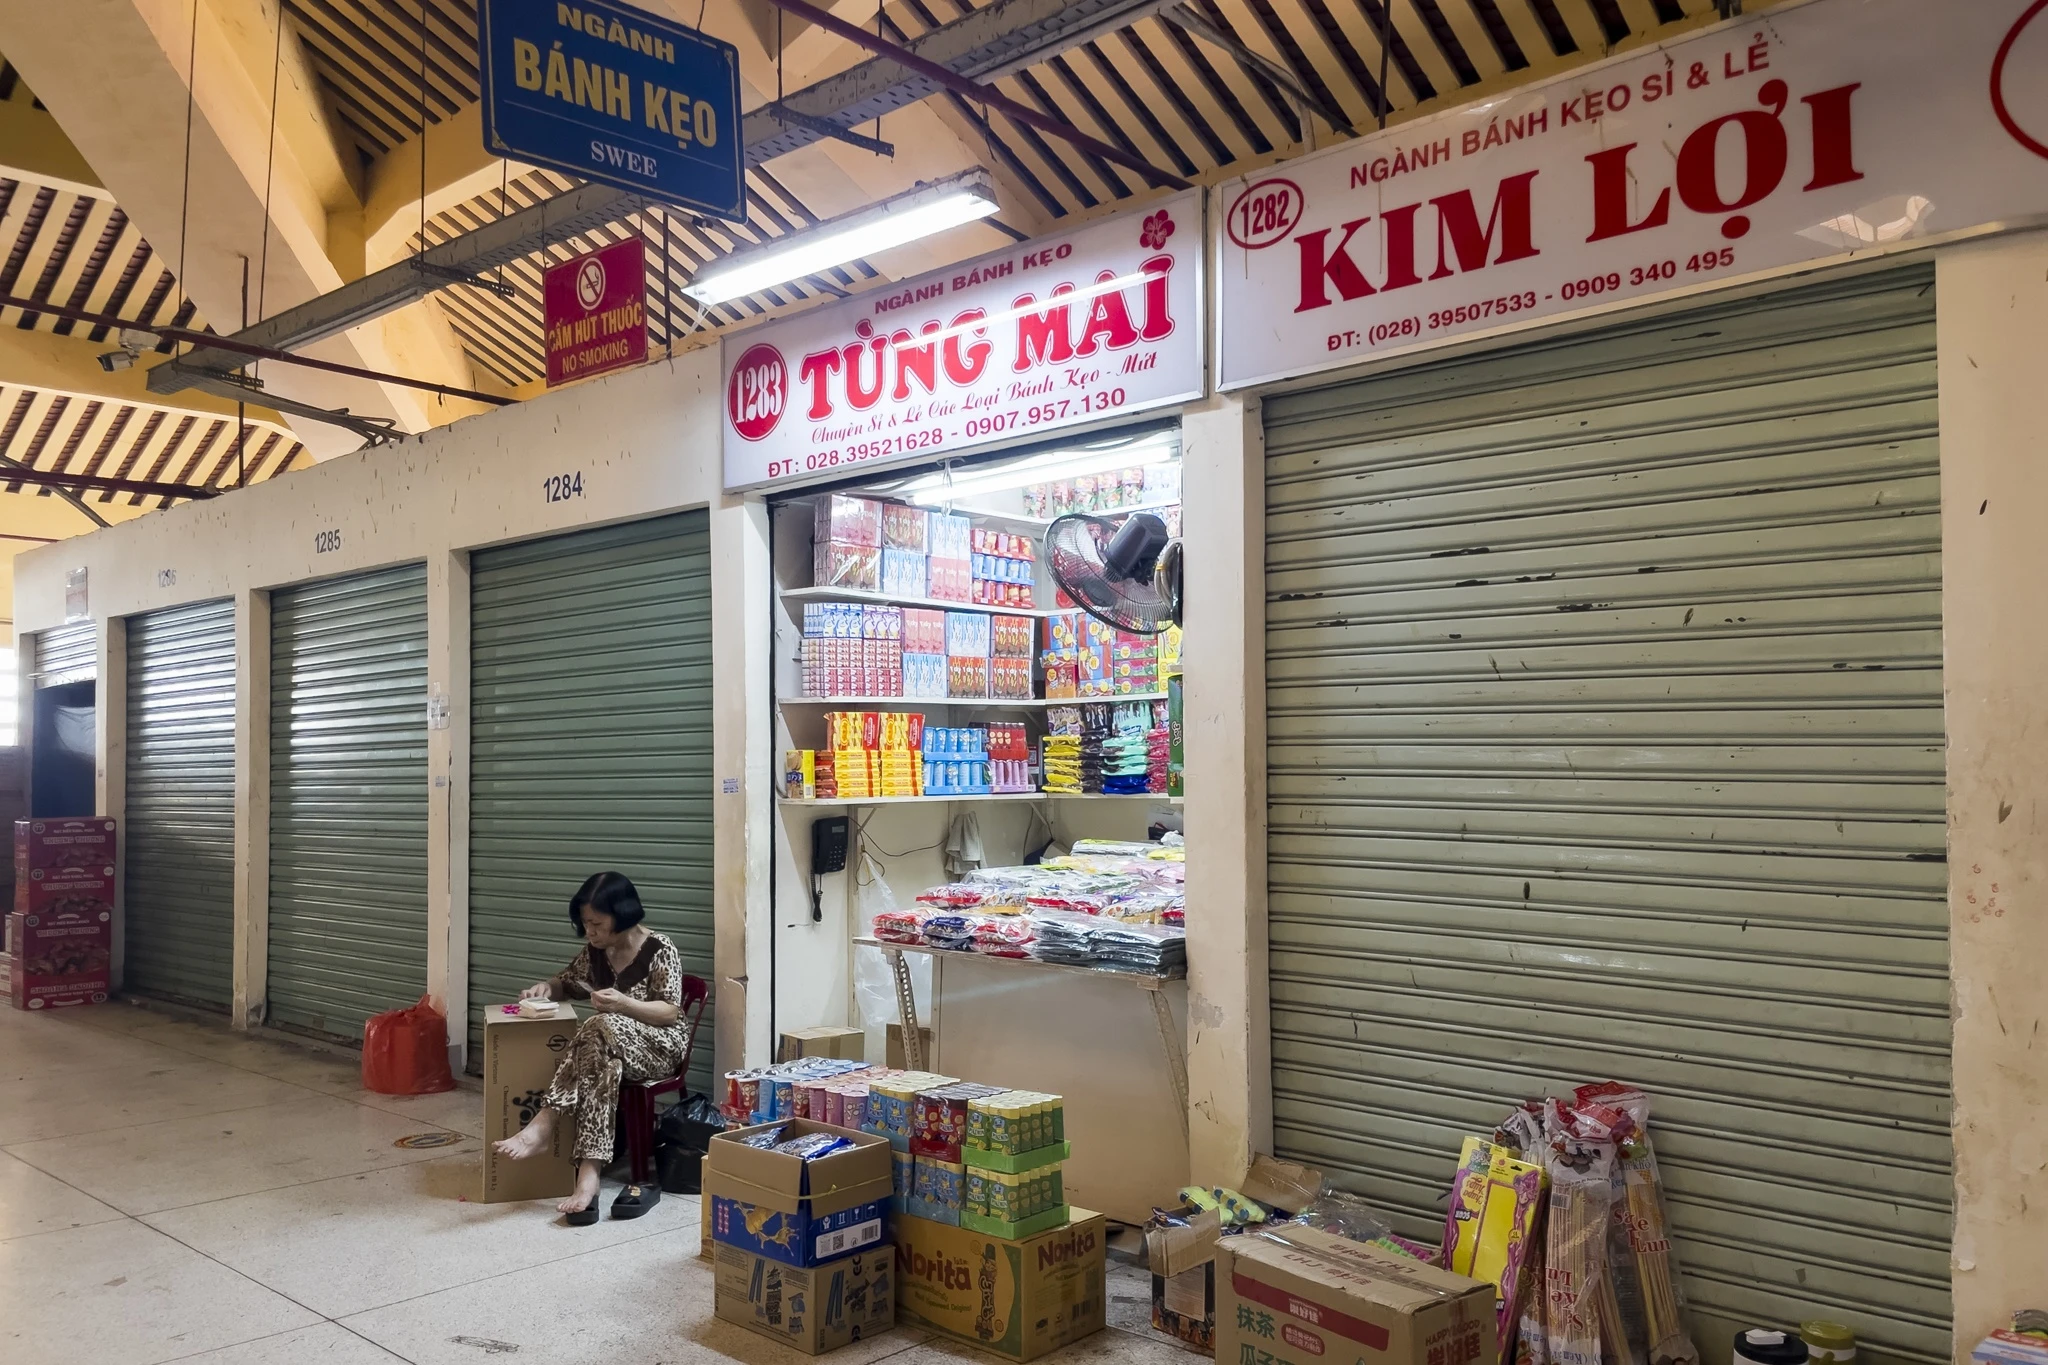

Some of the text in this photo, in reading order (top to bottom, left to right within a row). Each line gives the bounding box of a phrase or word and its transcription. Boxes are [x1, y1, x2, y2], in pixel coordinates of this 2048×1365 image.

[557, 4, 675, 65] NGÀNH
[514, 40, 718, 149] BÁNH KẸO
[1350, 138, 1450, 189] NGÀNH
[1461, 107, 1548, 157] BÁNH
[1560, 84, 1631, 127] KẸO
[1686, 61, 1710, 90] &
[1724, 31, 1769, 80] LẺ
[591, 140, 658, 179] SWEE
[1241, 189, 1290, 239] 1282
[1293, 79, 1865, 314] KIM LỢI
[874, 243, 1073, 315] NGÀNH BÁNH KẸO
[1327, 330, 1361, 351] ĐT:
[1368, 316, 1421, 346] (028)
[1428, 290, 1537, 329] 39507533
[1560, 272, 1621, 301] 0909
[1630, 259, 1676, 286] 340
[1686, 246, 1735, 273] 495
[548, 293, 642, 353] CẤM HÚT THUỐC
[1011, 254, 1176, 374] MAI
[562, 338, 628, 374] NO SMOKING
[736, 360, 783, 424] 1283
[887, 414, 897, 427] &
[928, 400, 956, 419] Các
[960, 387, 1000, 412] Loại
[1006, 374, 1054, 400] Bánh
[1060, 368, 1099, 389] Kẹo
[1116, 351, 1158, 377] Mứt
[768, 459, 799, 478] ĐT:
[806, 428, 943, 470] 028.39521628
[965, 387, 1126, 438] 0907.957.130
[543, 470, 583, 503] 1284
[315, 529, 341, 554] 1285
[892, 1241, 972, 1291] Norita
[1037, 1231, 1096, 1272] Norita
[1236, 1303, 1276, 1340] 抹茶
